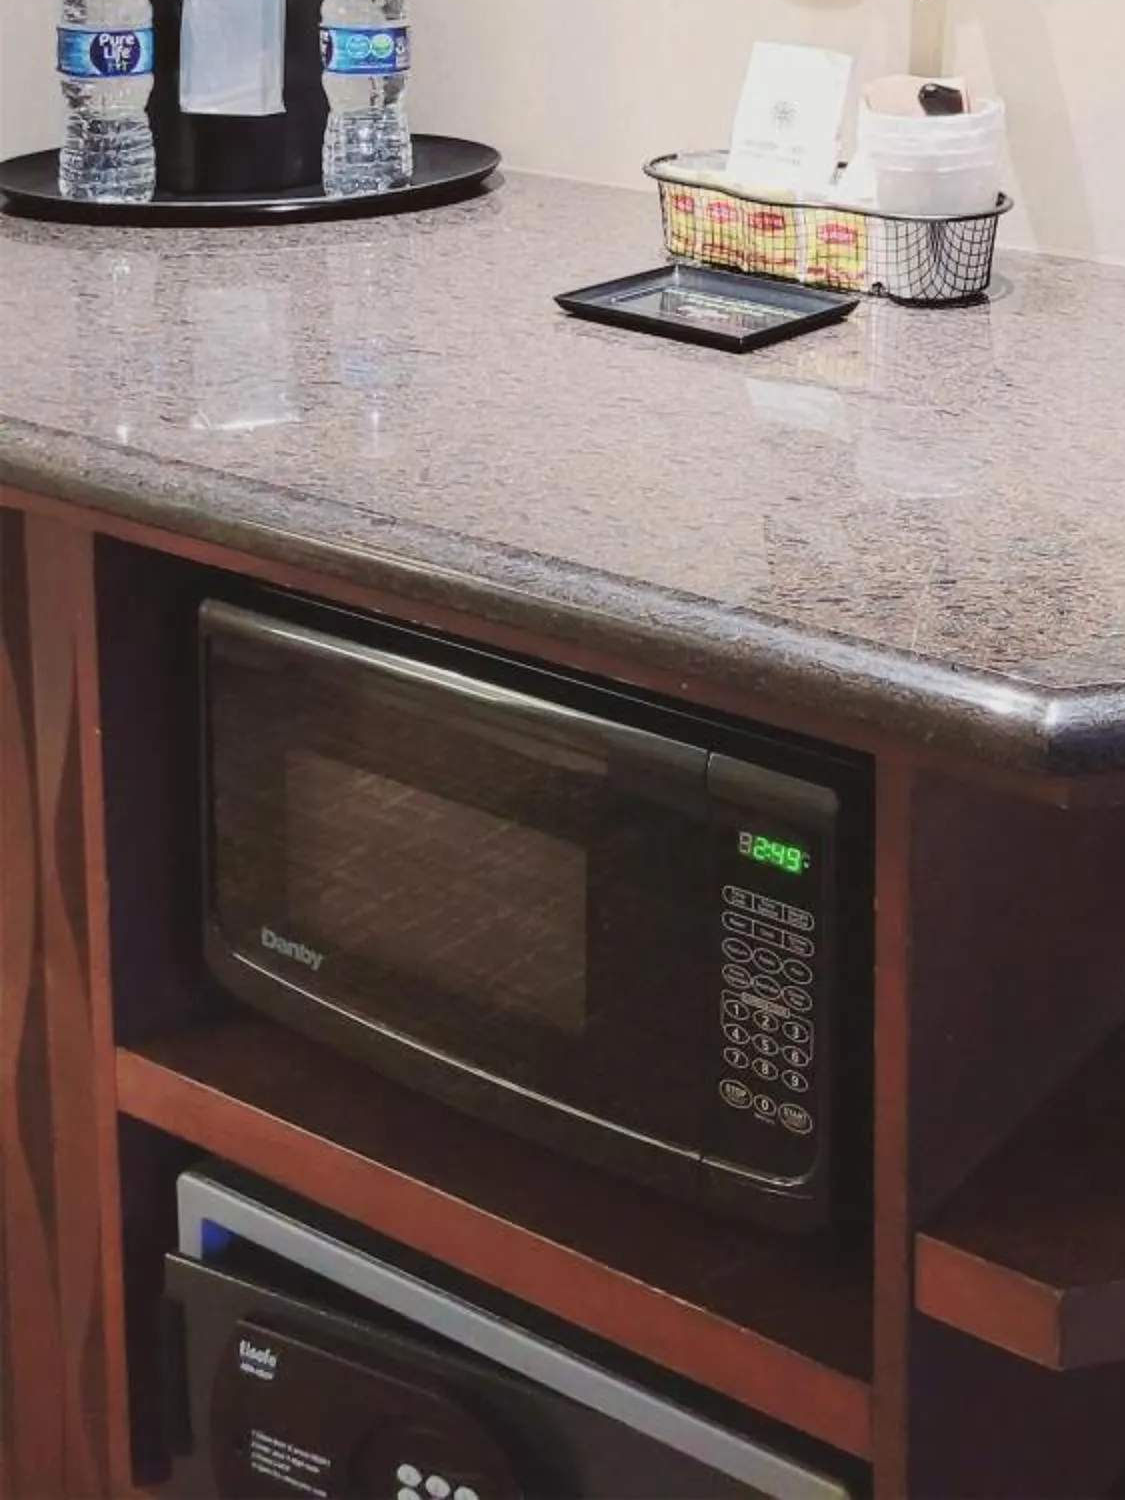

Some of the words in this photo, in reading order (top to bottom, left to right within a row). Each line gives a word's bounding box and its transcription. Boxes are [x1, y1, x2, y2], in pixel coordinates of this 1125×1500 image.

[99, 33, 135, 46] Pure
[103, 45, 131, 63] Life
[261, 926, 323, 971] Danby
